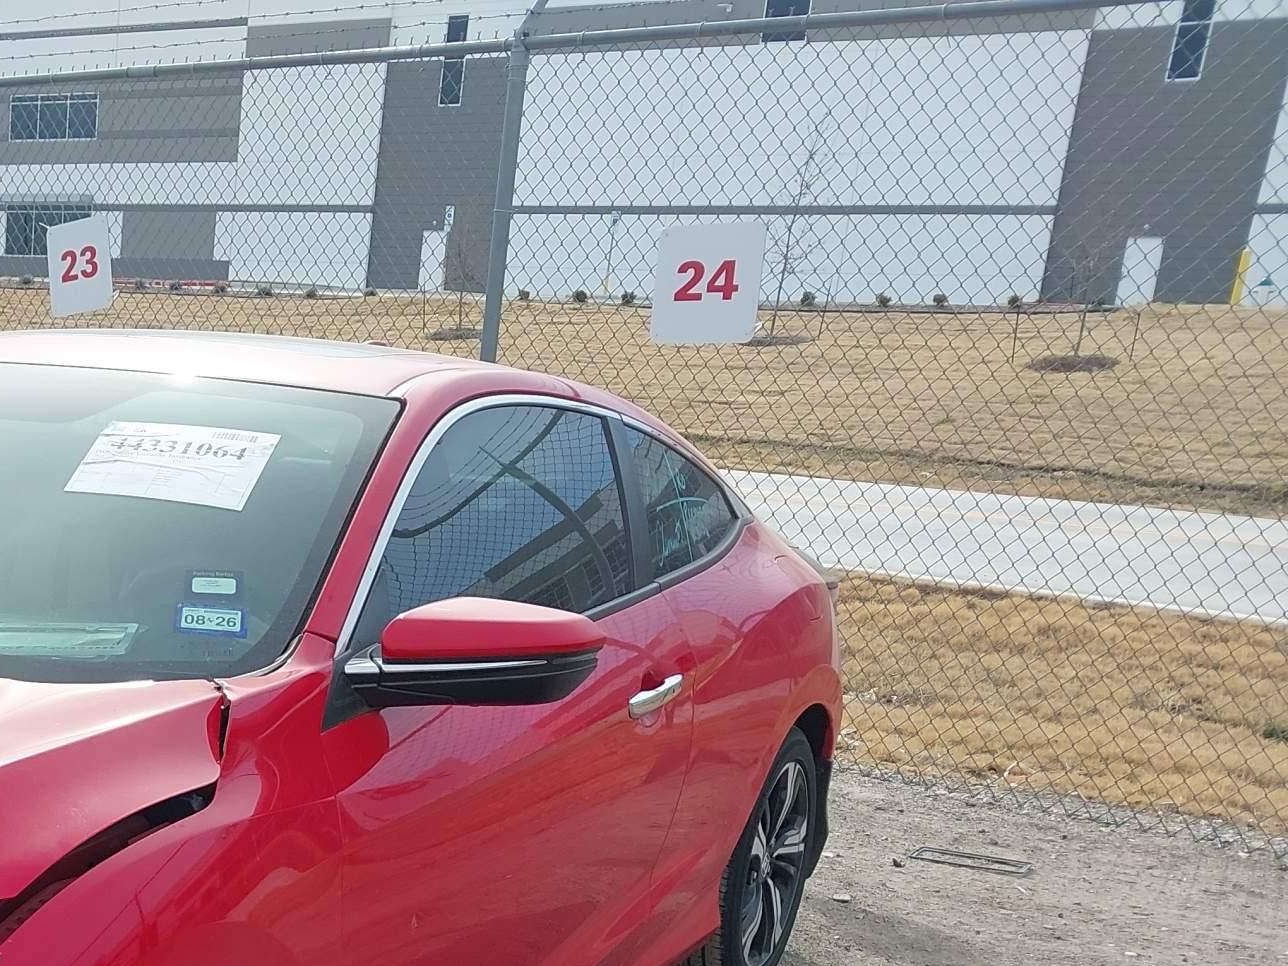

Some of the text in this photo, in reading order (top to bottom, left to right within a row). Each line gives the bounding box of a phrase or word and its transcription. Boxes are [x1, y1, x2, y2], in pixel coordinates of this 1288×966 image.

[60, 245, 98, 284] 23
[673, 259, 739, 302] 24
[110, 436, 248, 461] 44331064
